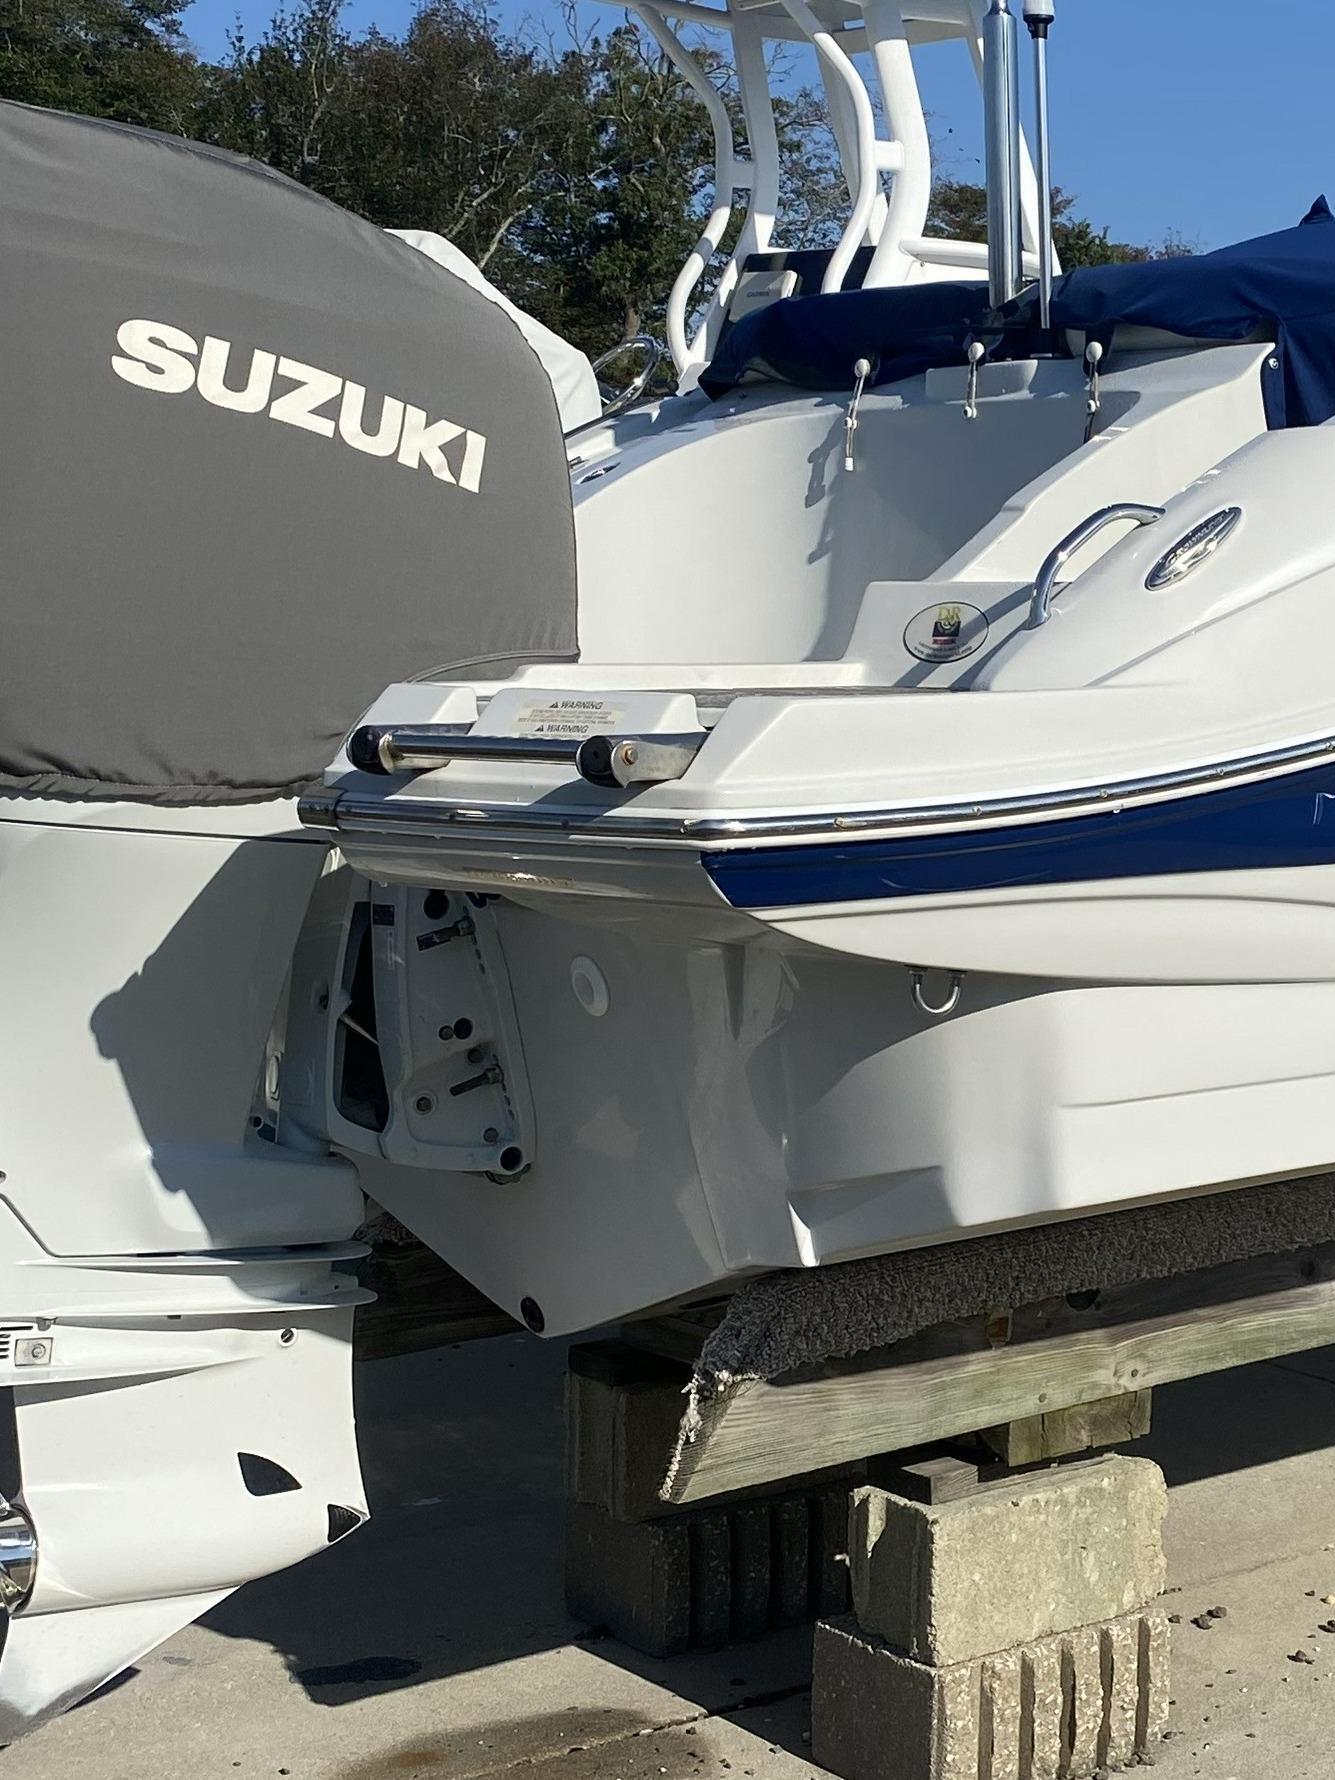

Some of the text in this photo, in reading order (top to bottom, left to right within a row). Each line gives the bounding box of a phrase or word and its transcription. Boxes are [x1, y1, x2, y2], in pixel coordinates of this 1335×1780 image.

[111, 319, 487, 494] SUZUKI
[560, 700, 604, 710] WARNING
[546, 724, 590, 734] WARNING
